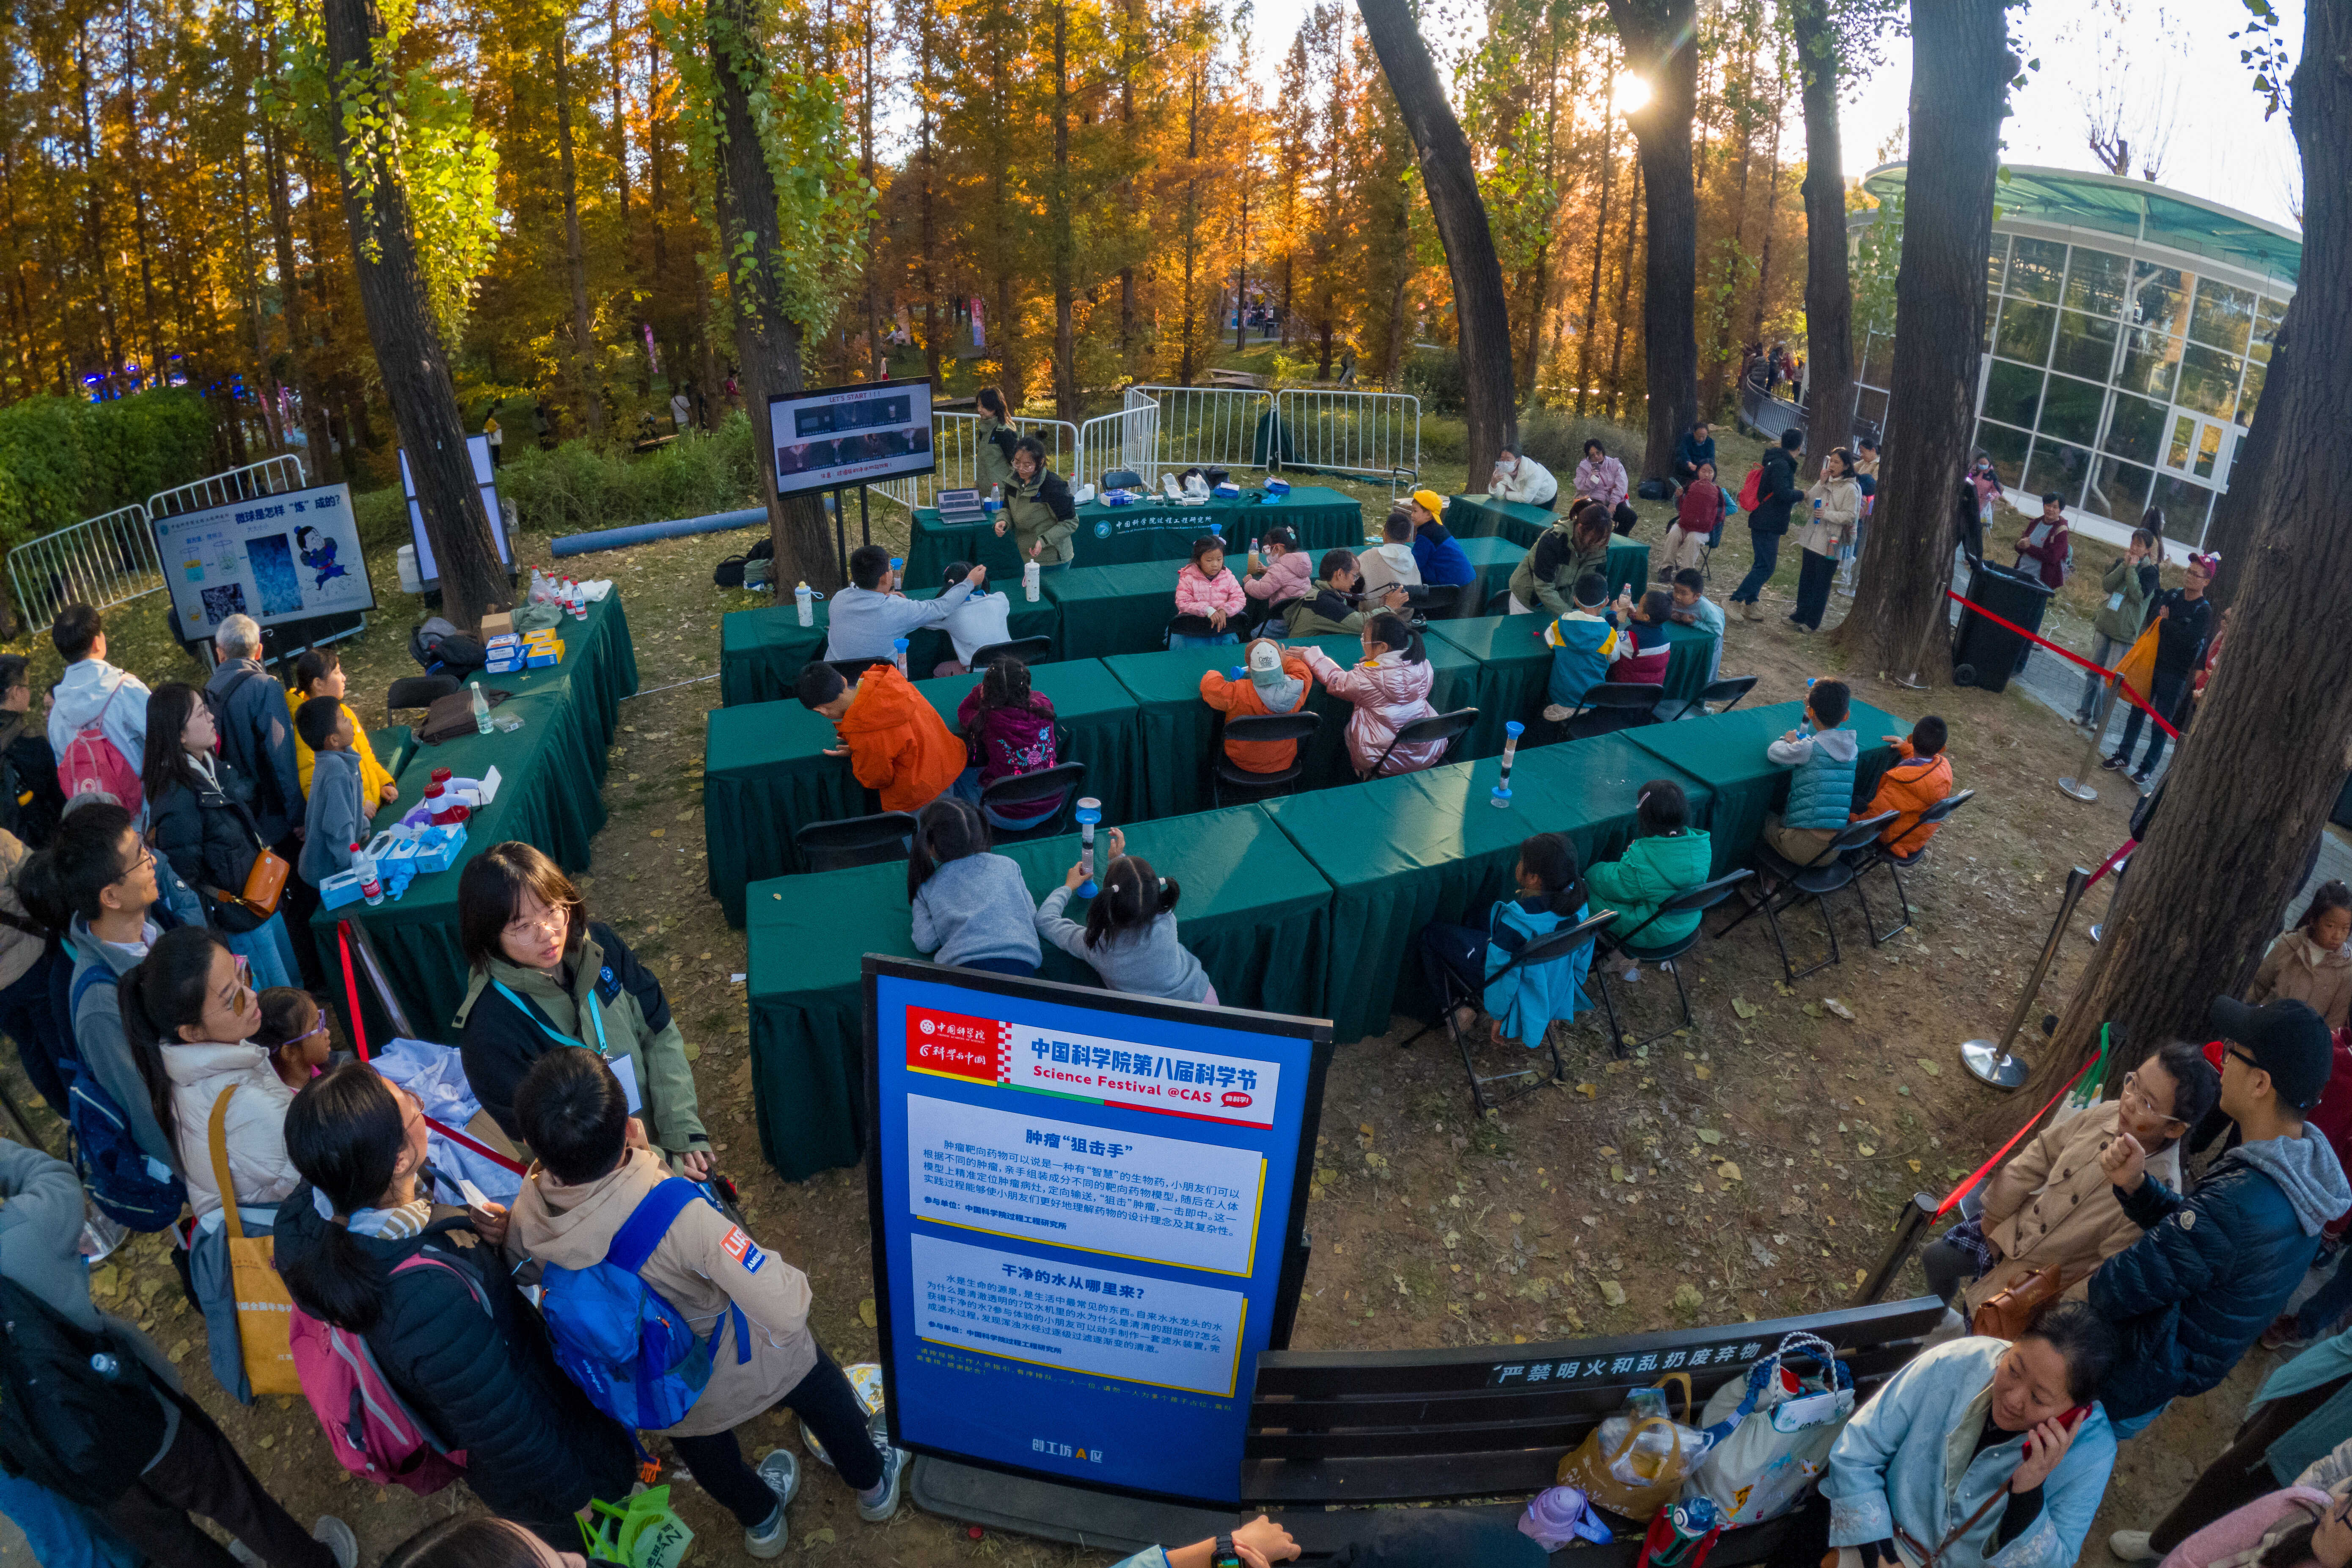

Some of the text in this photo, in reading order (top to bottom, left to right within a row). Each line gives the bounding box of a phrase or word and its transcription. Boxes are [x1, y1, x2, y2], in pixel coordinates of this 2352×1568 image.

[830, 395, 845, 403] LET'S
[847, 393, 867, 401] START
[1116, 516, 1212, 530] 中国科学院过程工程研究所
[937, 1022, 985, 1040] 中国科学院
[1031, 1038, 1257, 1091] 中国科学院第八届科学节
[1033, 1065, 1212, 1103] Science Festival @CAS
[1026, 1128, 1133, 1158] 肿瘤“狙击手”
[1002, 1263, 1144, 1299] 干净的水从哪里来？
[1498, 1342, 1762, 1384] 严禁明火和乱扔废弃物
